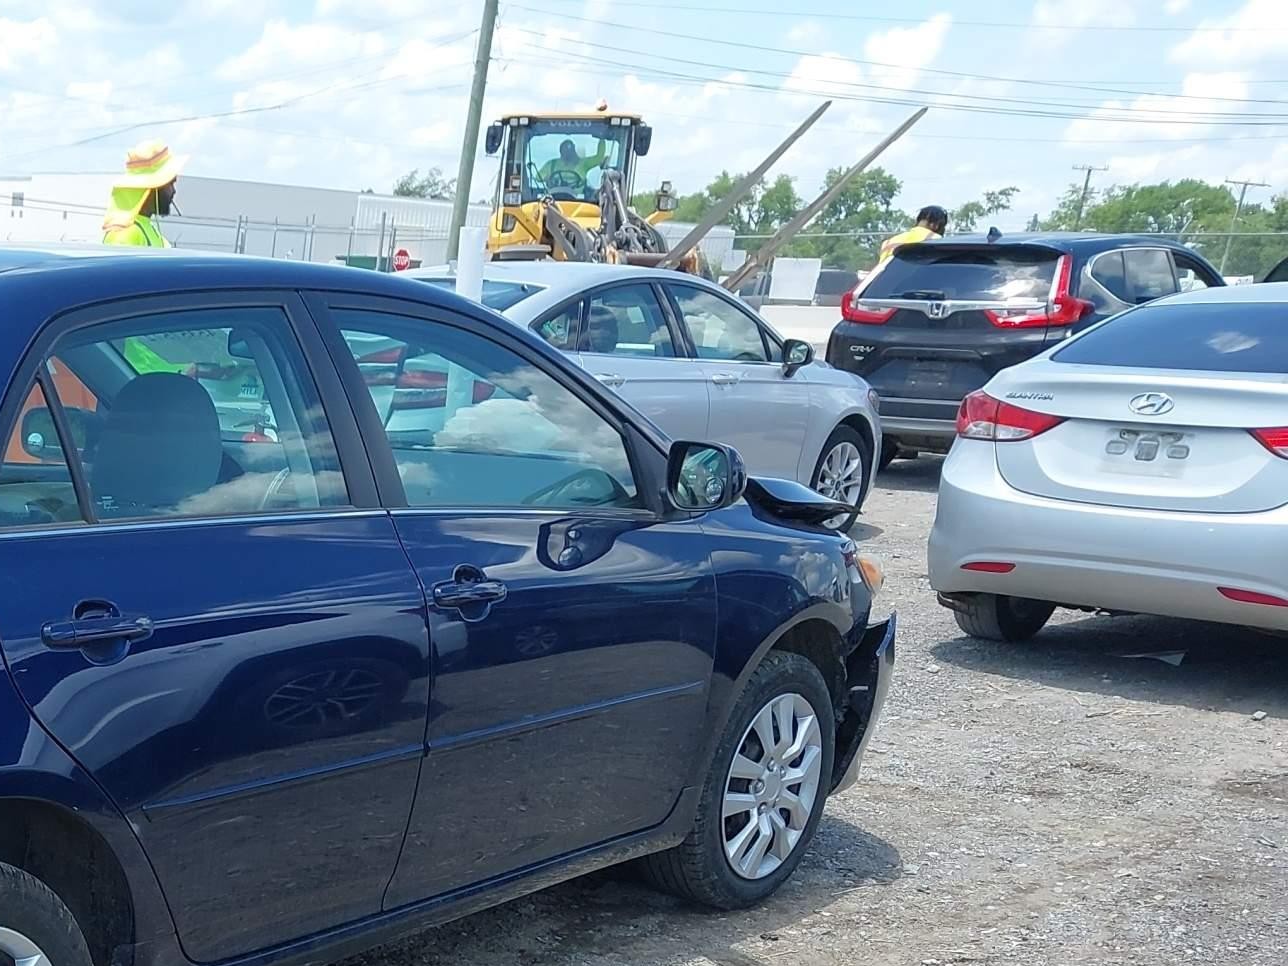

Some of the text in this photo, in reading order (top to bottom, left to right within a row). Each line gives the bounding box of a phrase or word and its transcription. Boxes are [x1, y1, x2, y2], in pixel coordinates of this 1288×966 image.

[550, 119, 592, 127] VOLVO
[394, 254, 409, 265] STOP
[849, 344, 875, 353] CR-V
